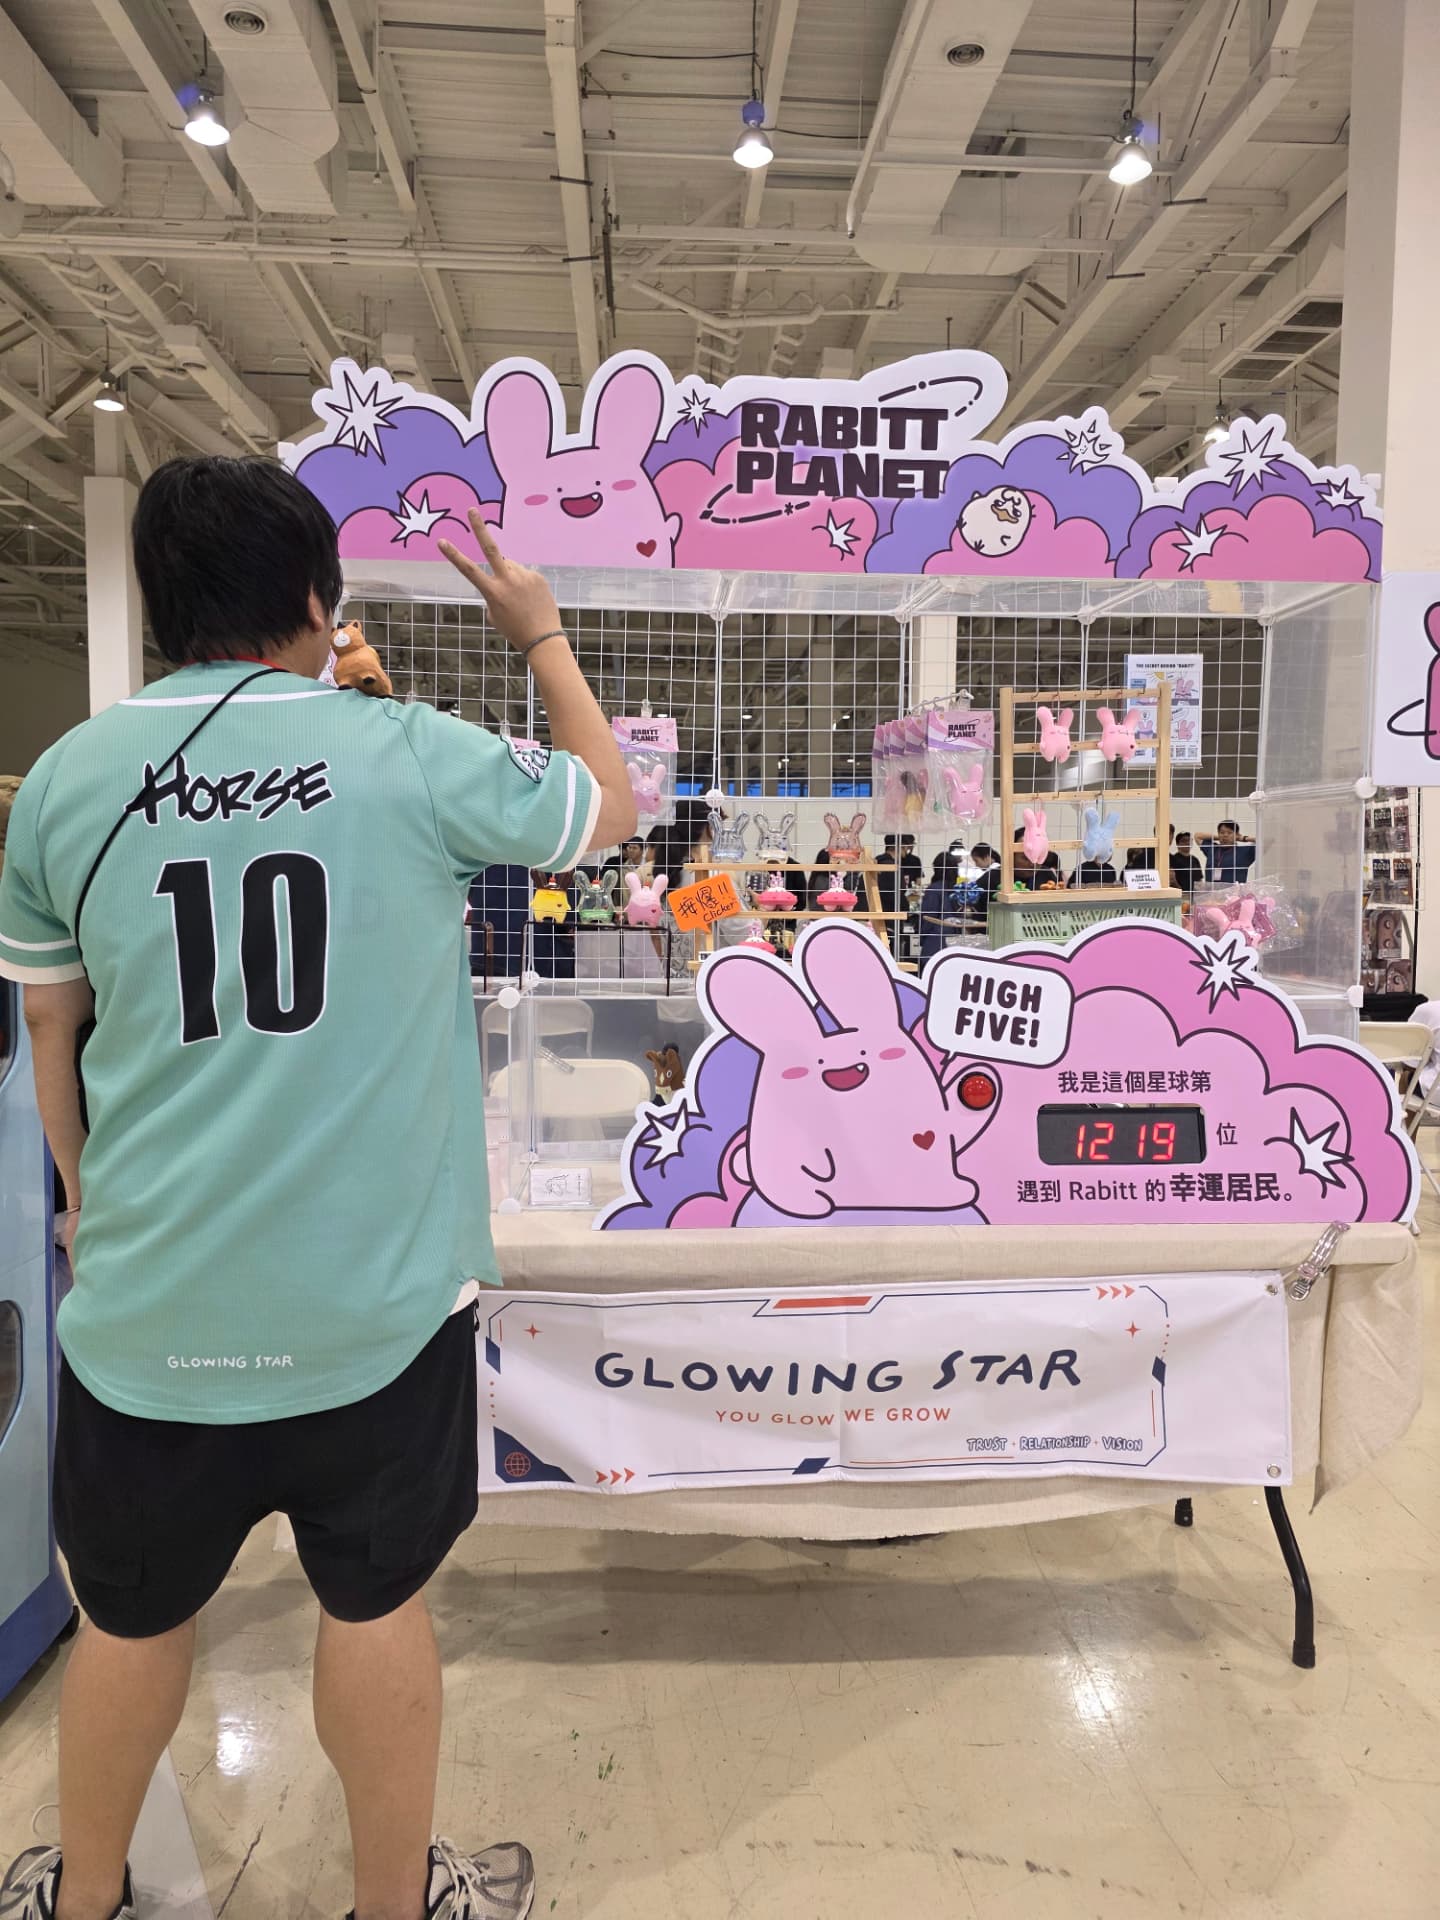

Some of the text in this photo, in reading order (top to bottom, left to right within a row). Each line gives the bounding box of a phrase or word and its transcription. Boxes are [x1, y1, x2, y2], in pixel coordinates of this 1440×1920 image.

[741, 402, 949, 451] RABITT
[736, 450, 950, 500] PLANET
[124, 753, 334, 826] HORSE
[703, 901, 735, 923] Clicker
[152, 850, 330, 1046] 10
[960, 973, 1042, 1013] HIGH
[955, 1007, 1040, 1047] FIVE!
[1058, 1070, 1212, 1093] 我是這個星球第
[1216, 1122, 1238, 1146] 位
[1017, 1180, 1061, 1202] 遇到
[1069, 1180, 1138, 1200] Rabitt
[167, 1354, 294, 1369] GLOWING STAR
[595, 1349, 1081, 1396] GLOWING STAR
[715, 1407, 951, 1426] YOU GLOW WE GROW
[966, 1435, 1143, 1452] TRUST RELATIONSHIP VISION
